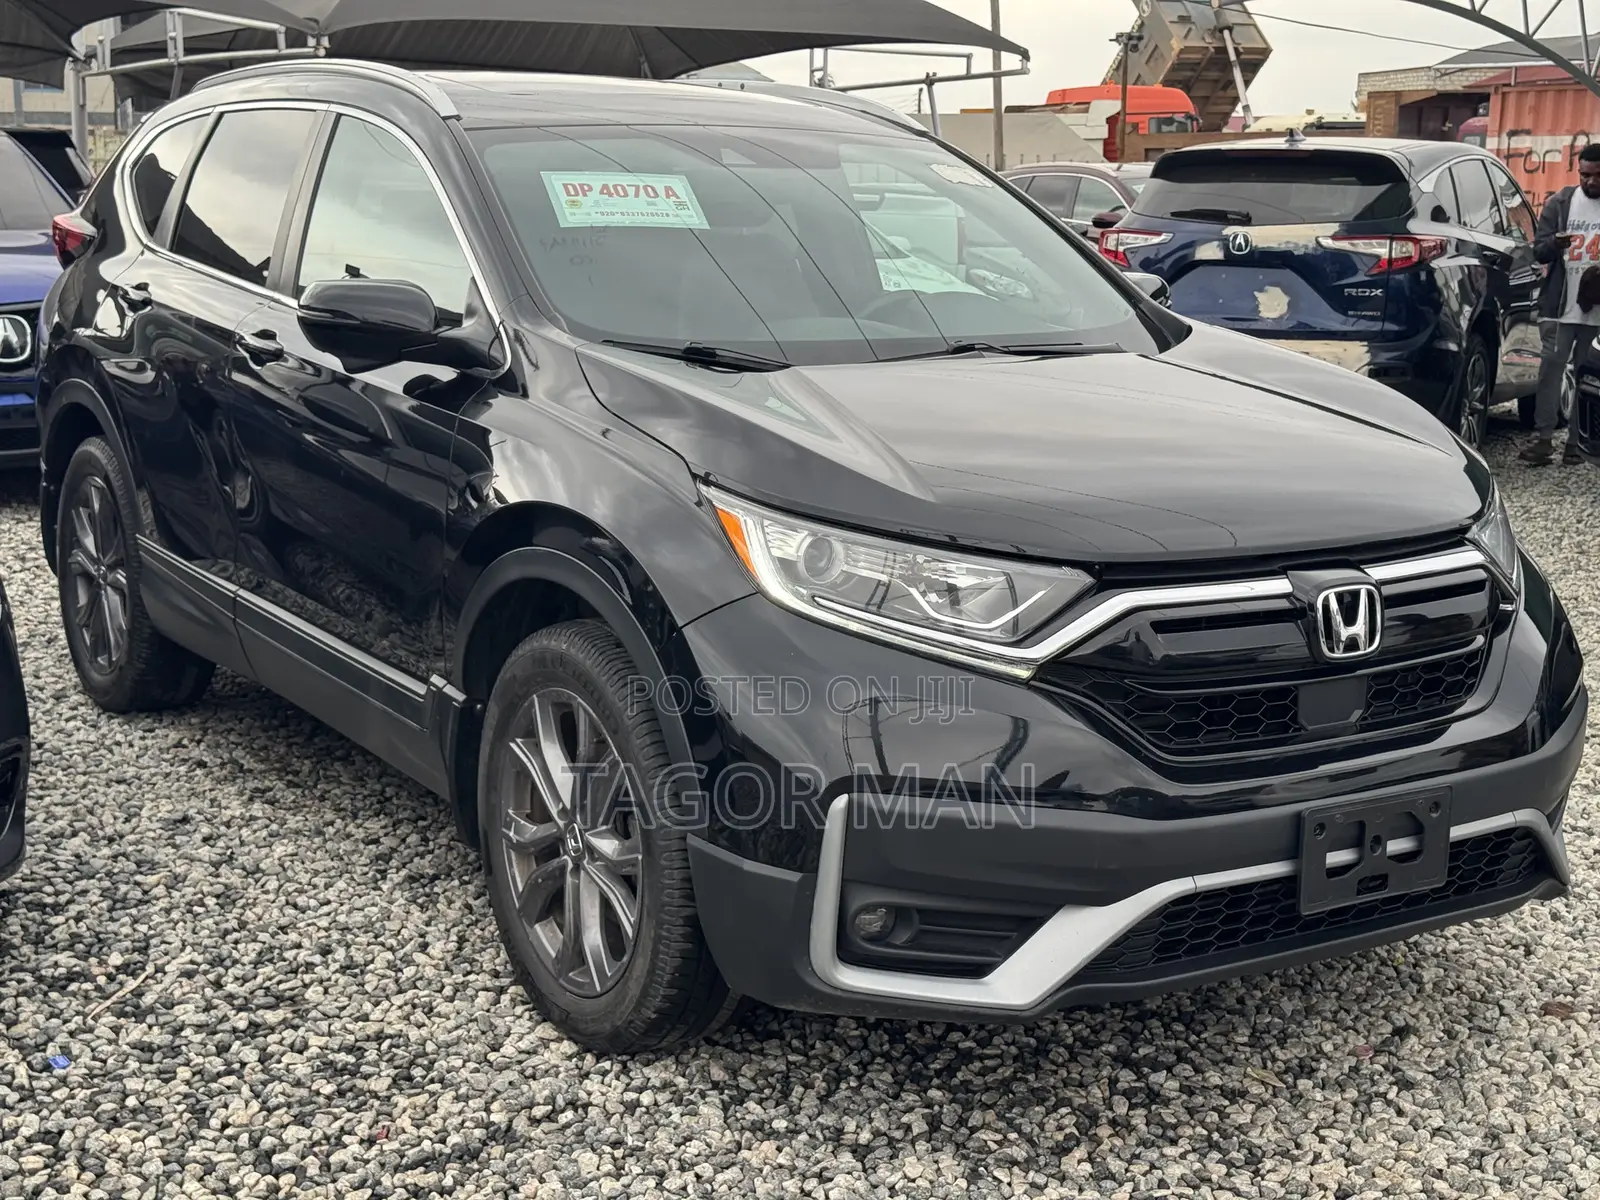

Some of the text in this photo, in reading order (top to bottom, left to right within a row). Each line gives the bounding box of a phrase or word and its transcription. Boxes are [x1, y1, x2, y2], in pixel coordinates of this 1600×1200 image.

[1504, 129, 1562, 174] For
[562, 182, 681, 200] DP 4070 A
[1568, 233, 1600, 262] 24
[1344, 288, 1384, 297] RDX
